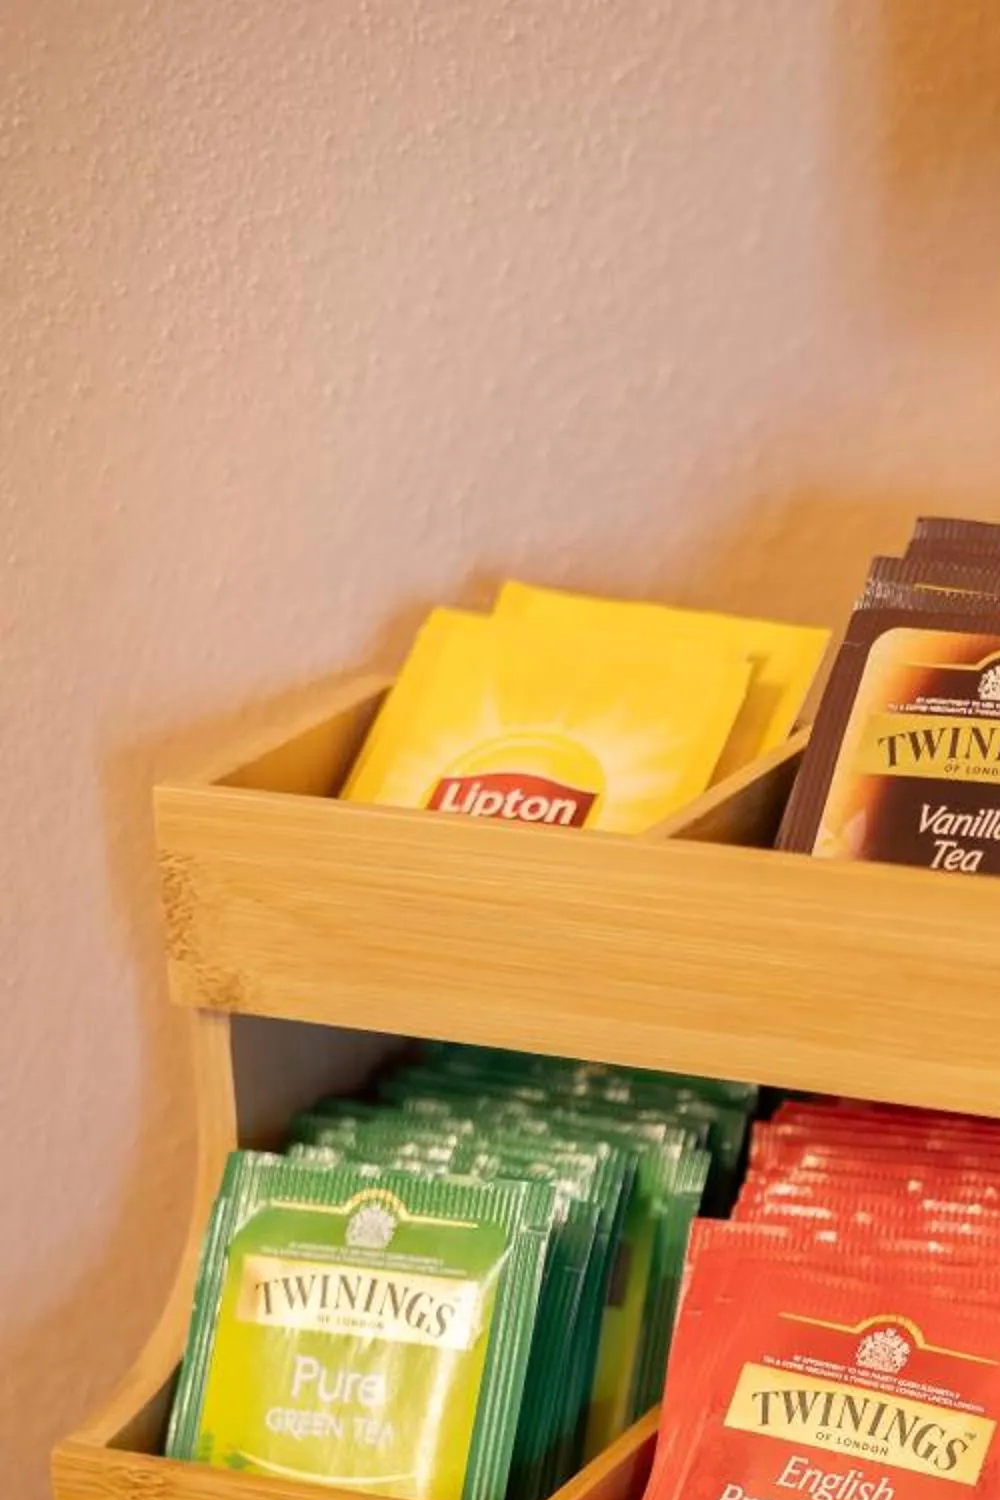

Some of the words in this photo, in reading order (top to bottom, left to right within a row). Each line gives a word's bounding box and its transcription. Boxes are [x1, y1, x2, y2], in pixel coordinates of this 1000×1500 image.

[440, 781, 577, 826] Lipton
[930, 839, 984, 873] Tea
[256, 1274, 456, 1339] TWININGS
[290, 1353, 387, 1408] Pure
[752, 1389, 968, 1472] TWININGS
[815, 1431, 832, 1442] OF
[836, 1433, 889, 1457] LONDON
